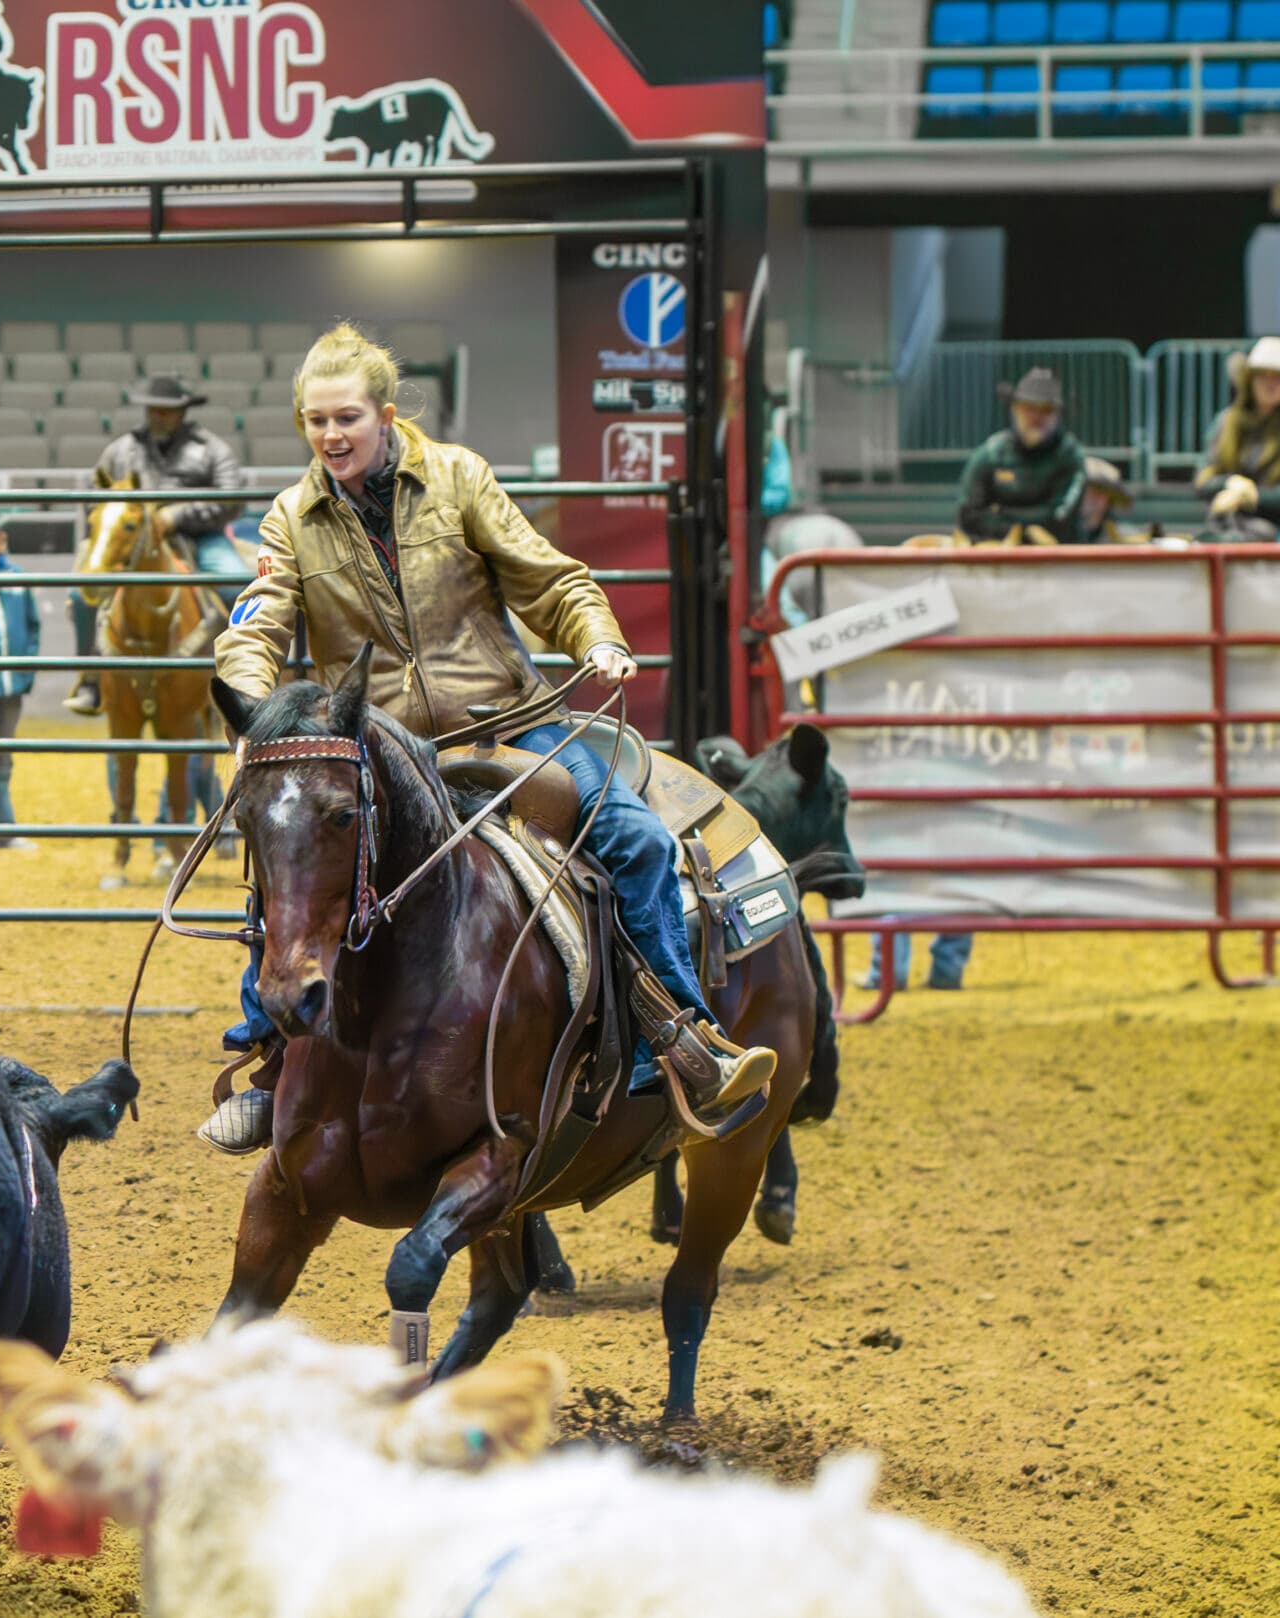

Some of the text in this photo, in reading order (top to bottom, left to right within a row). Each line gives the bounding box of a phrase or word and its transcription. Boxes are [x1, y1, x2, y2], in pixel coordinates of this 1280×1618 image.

[56, 12, 316, 146] RSNC
[593, 242, 687, 269] CINC
[594, 382, 632, 403] Mil
[808, 597, 929, 653] NO HORSE TIES
